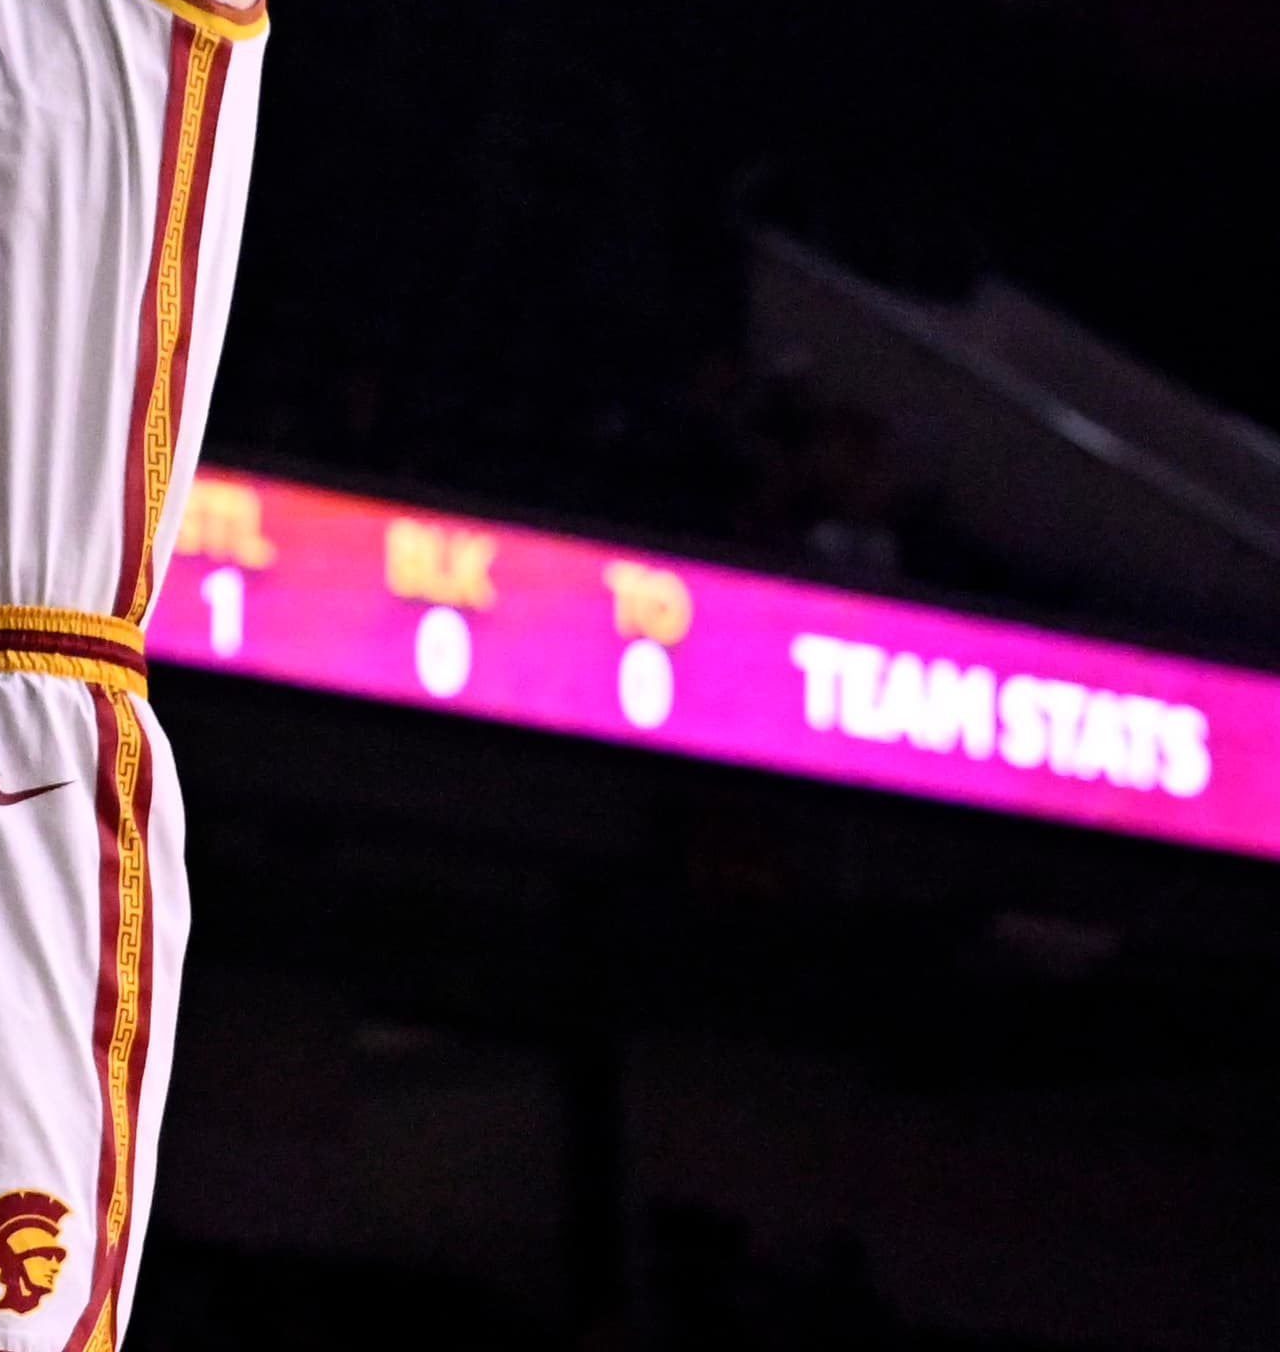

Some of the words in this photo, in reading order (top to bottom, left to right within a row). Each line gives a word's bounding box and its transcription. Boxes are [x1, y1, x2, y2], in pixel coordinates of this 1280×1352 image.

[201, 566, 244, 659] 1
[414, 605, 472, 699] 0
[618, 638, 674, 730] 0
[385, 517, 498, 611] BLK
[603, 559, 693, 646] TO
[790, 632, 997, 761] TEAM
[998, 674, 1212, 798] STATS
